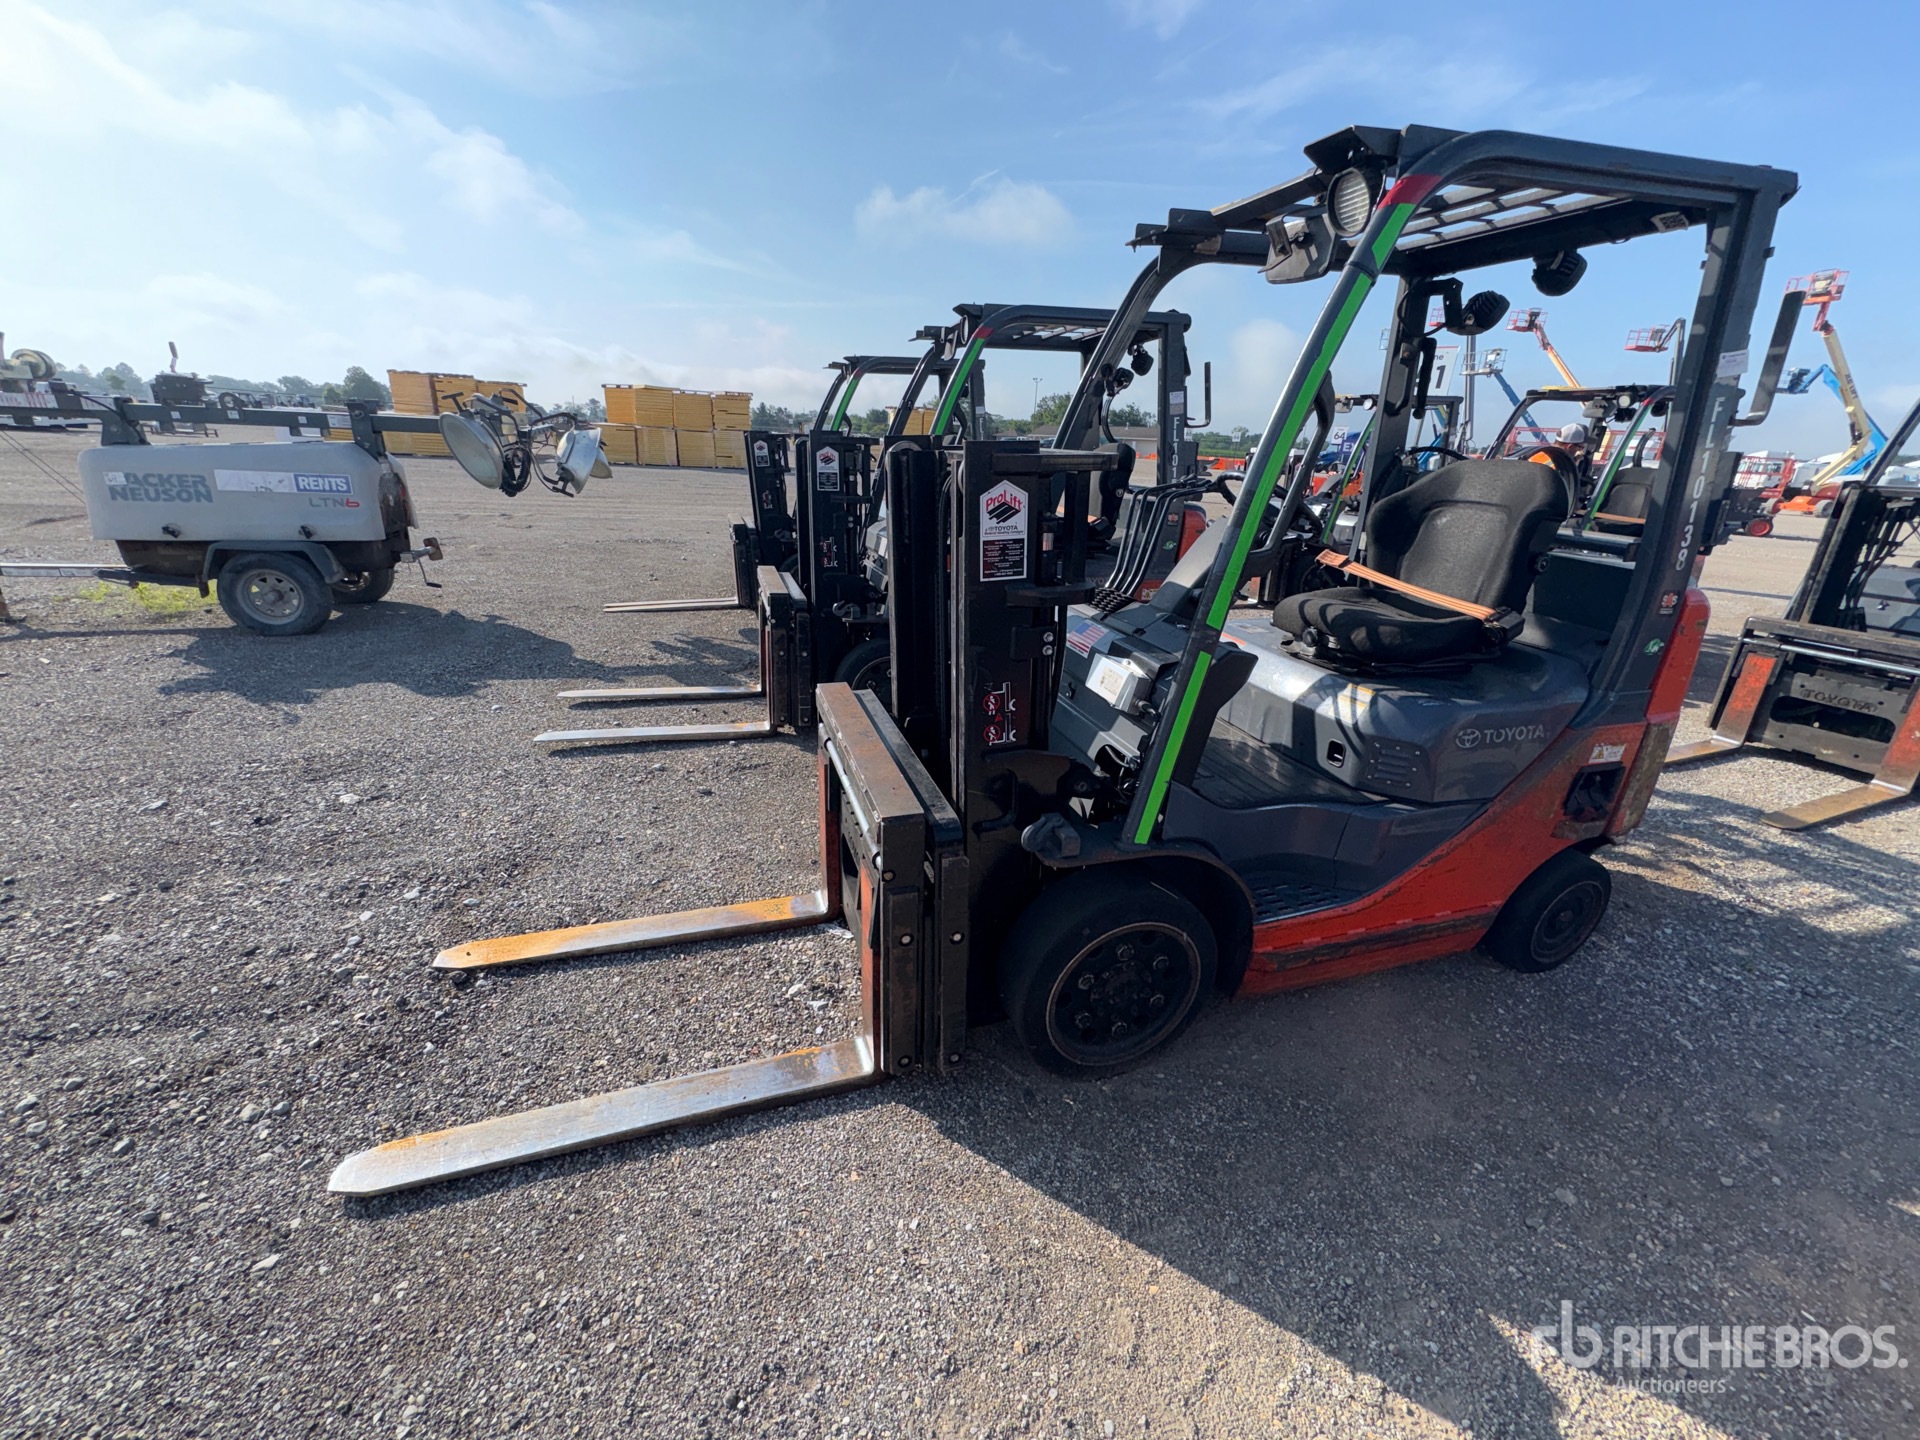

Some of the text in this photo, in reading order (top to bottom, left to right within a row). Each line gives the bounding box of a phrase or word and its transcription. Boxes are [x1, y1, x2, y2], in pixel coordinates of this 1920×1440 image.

[1333, 431, 1346, 440] 64
[1172, 416, 1180, 491] FL101
[123, 472, 208, 489] ACKER
[297, 476, 348, 491] RENTS
[1676, 397, 1725, 571] FL10138
[108, 486, 214, 503] NEUSON
[985, 489, 1023, 512] ProLift
[1804, 688, 1873, 713] TOYOTA
[1484, 725, 1545, 744] TOYOTA
